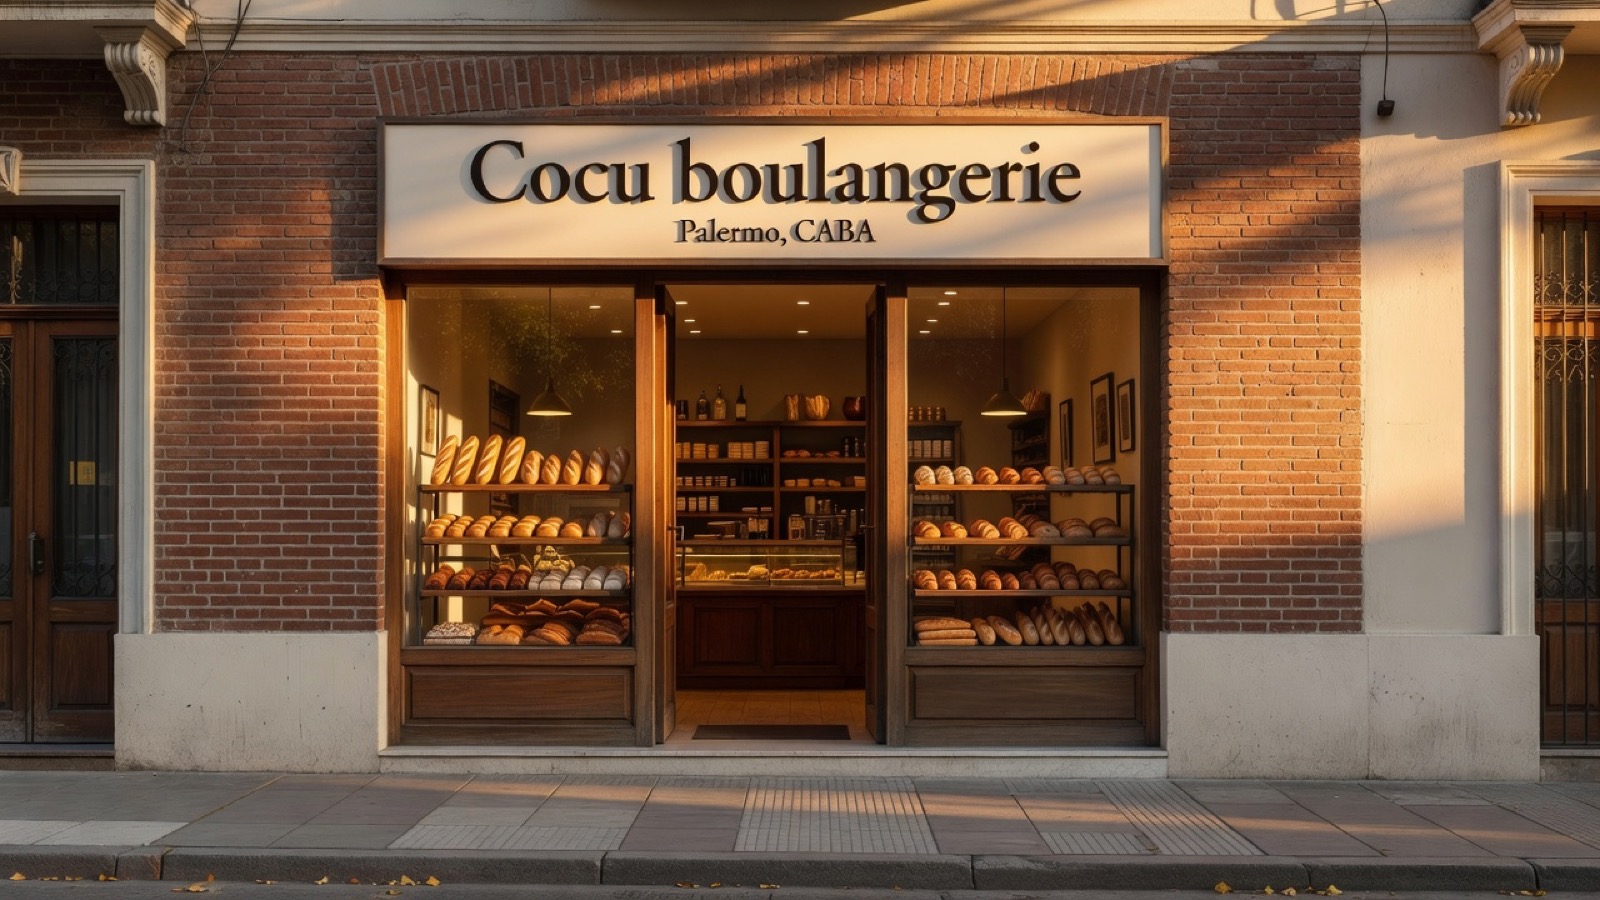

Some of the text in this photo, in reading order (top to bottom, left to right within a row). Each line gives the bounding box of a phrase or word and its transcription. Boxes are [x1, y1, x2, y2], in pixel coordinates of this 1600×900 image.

[470, 136, 1082, 223] Cocu boulangerie
[678, 218, 876, 246] Palermo, CABA
